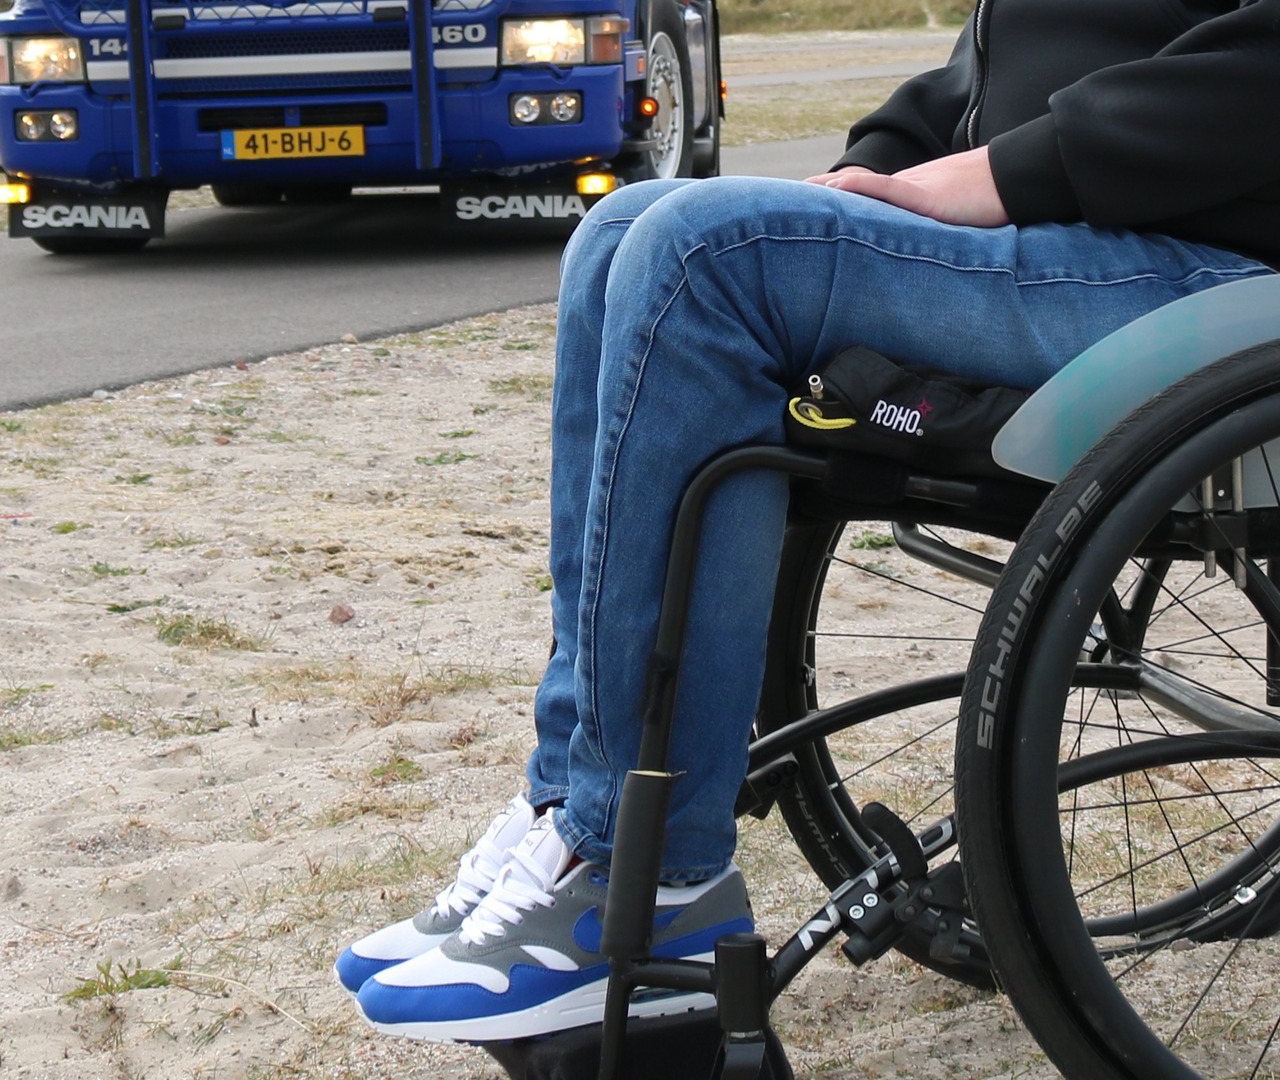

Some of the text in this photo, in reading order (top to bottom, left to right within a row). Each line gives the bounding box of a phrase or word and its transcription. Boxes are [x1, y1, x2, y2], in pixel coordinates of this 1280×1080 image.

[245, 131, 351, 154] 41-BHJ-6
[22, 204, 150, 229] SCANIA
[456, 195, 587, 220] SCANIA
[977, 480, 1103, 750] SCHWALBE
[794, 781, 851, 880] CHWAL
